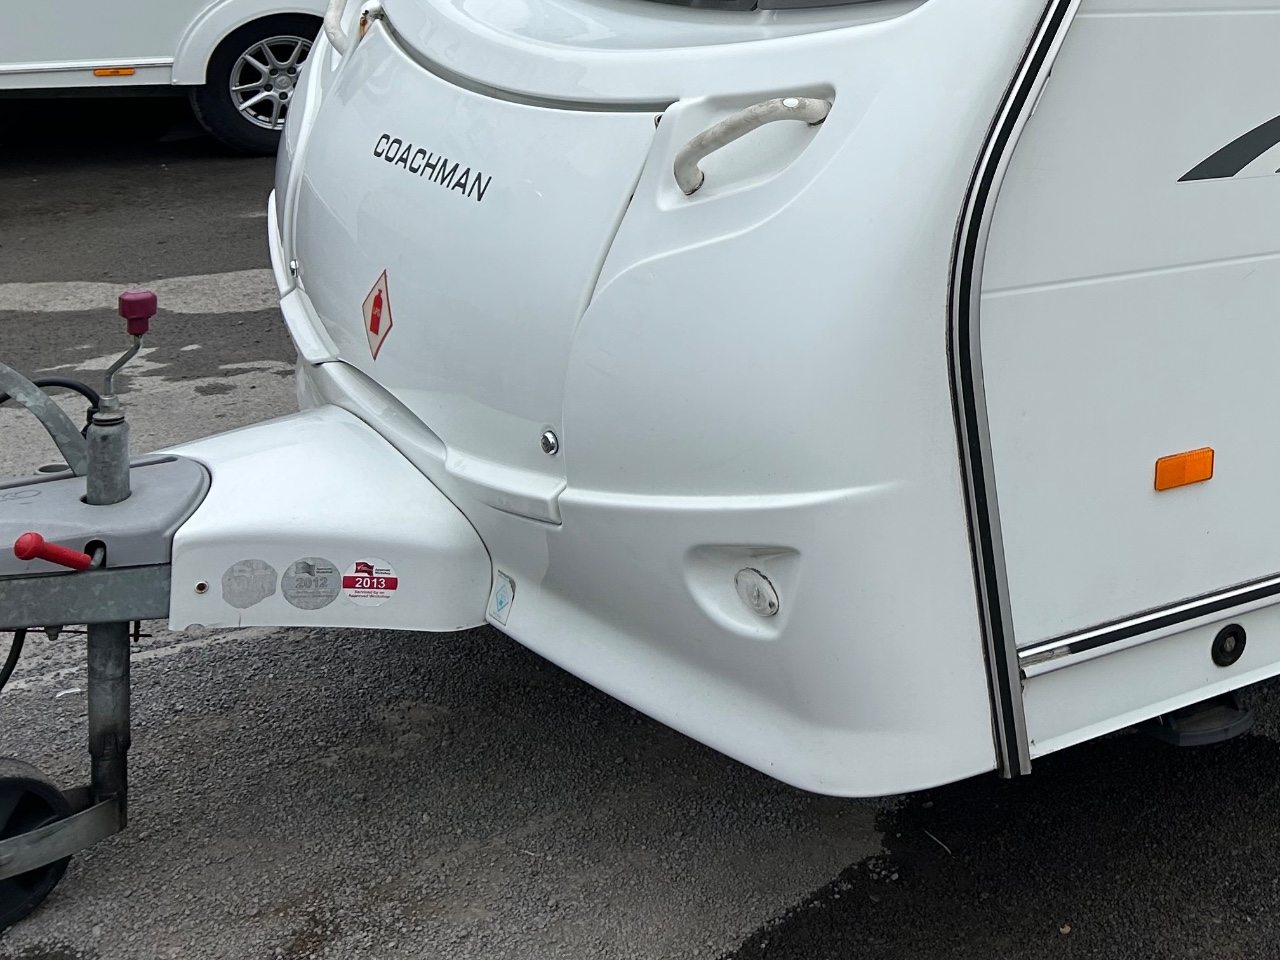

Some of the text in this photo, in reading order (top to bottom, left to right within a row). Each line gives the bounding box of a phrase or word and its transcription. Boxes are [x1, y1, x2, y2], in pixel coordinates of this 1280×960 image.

[373, 133, 492, 202] COACHMAN
[295, 577, 328, 588] 2012
[355, 577, 386, 588] 2013
